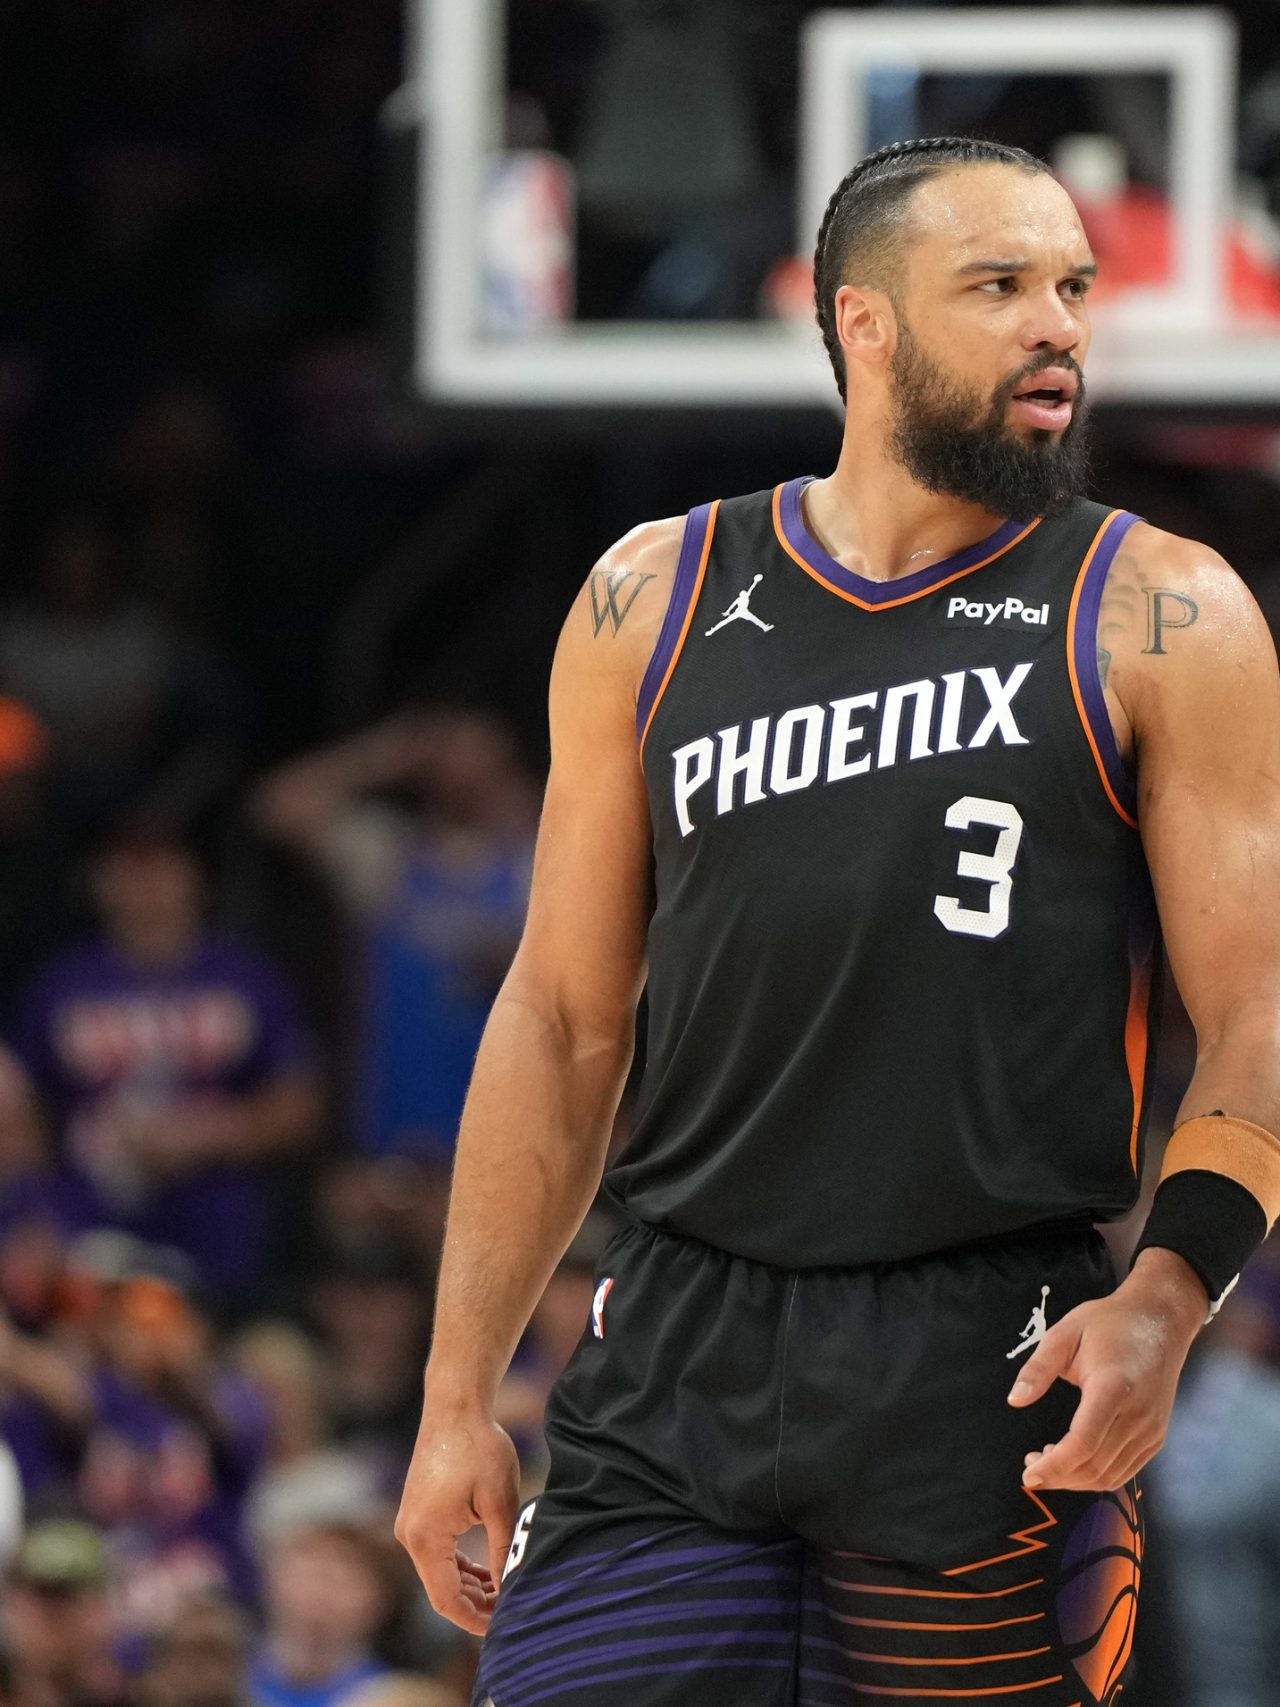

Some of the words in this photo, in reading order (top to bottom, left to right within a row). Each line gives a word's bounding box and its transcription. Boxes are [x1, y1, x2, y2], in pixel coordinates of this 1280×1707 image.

[589, 570, 657, 639] W
[947, 597, 1050, 625] PayPal
[1141, 587, 1199, 655] P
[671, 661, 1036, 838] PHOENIX
[933, 795, 1025, 940] 3
